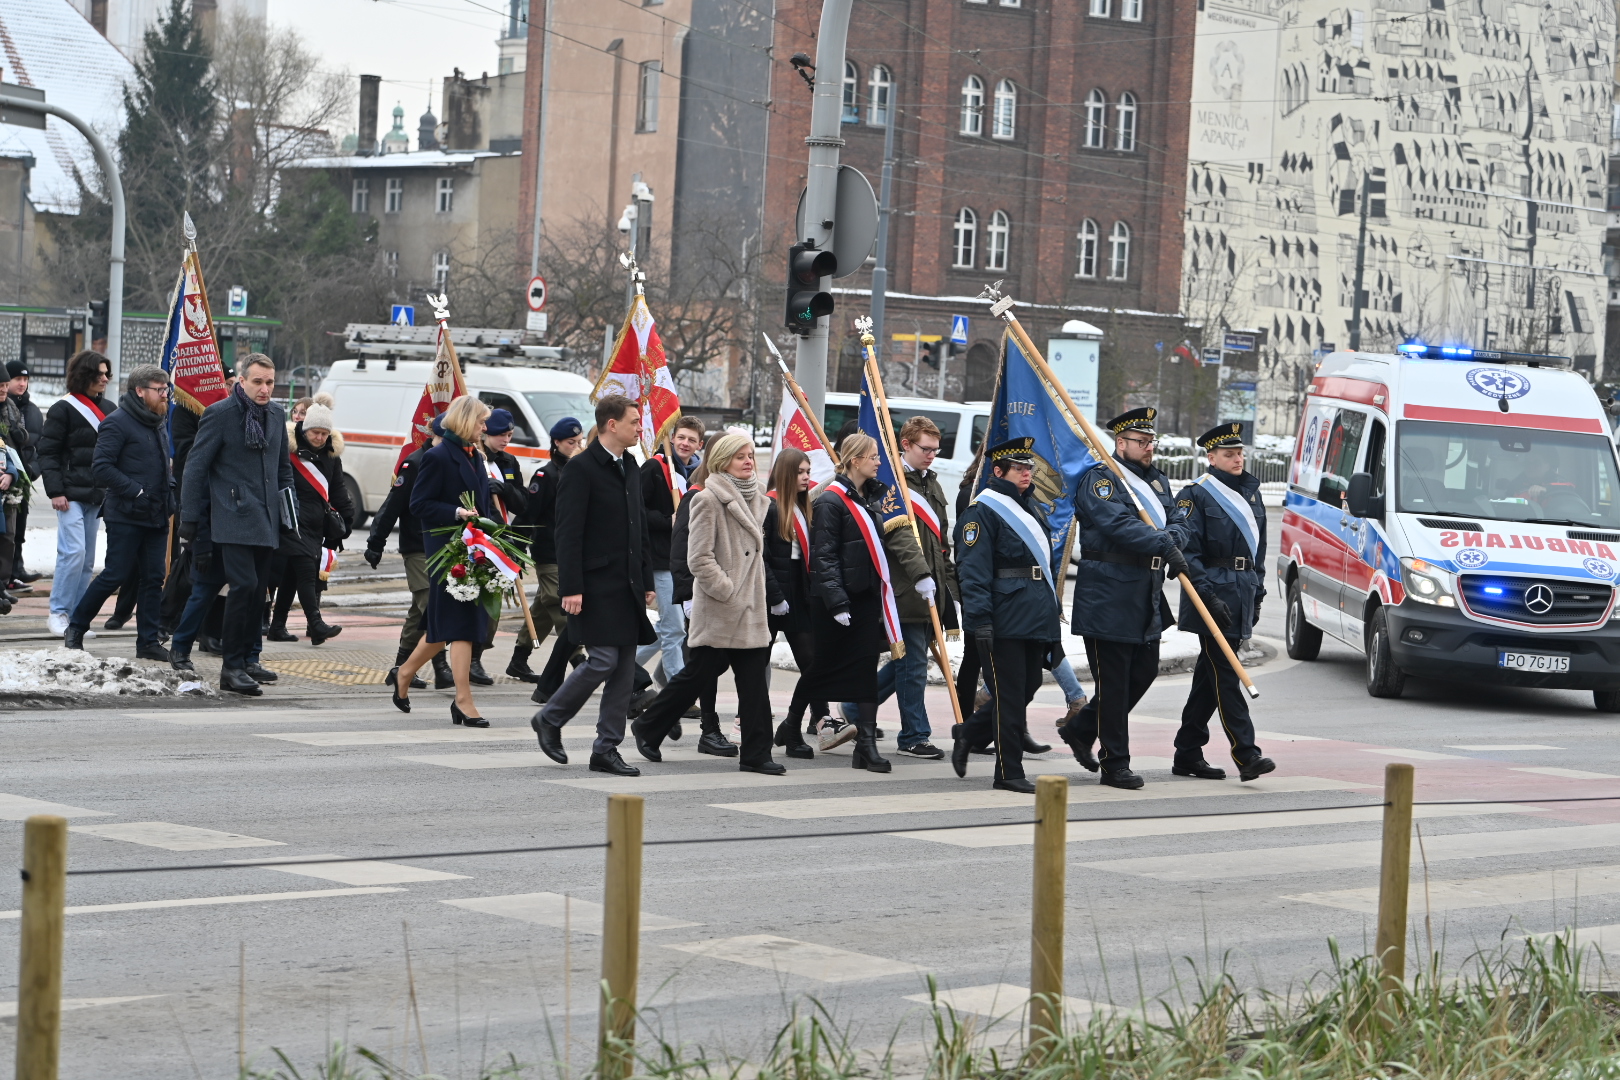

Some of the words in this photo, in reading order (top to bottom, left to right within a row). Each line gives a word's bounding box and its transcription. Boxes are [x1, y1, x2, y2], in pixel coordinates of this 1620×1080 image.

[1197, 109, 1249, 131] MENNICA
[177, 345, 200, 358] IĄZEK
[176, 363, 221, 378] STALINOWSK
[422, 382, 450, 397] JOWA
[1007, 401, 1036, 416] ZIEJE
[790, 423, 812, 449] PAŁAC
[1506, 654, 1525, 667] PO
[1529, 655, 1568, 670] 7GJ15
